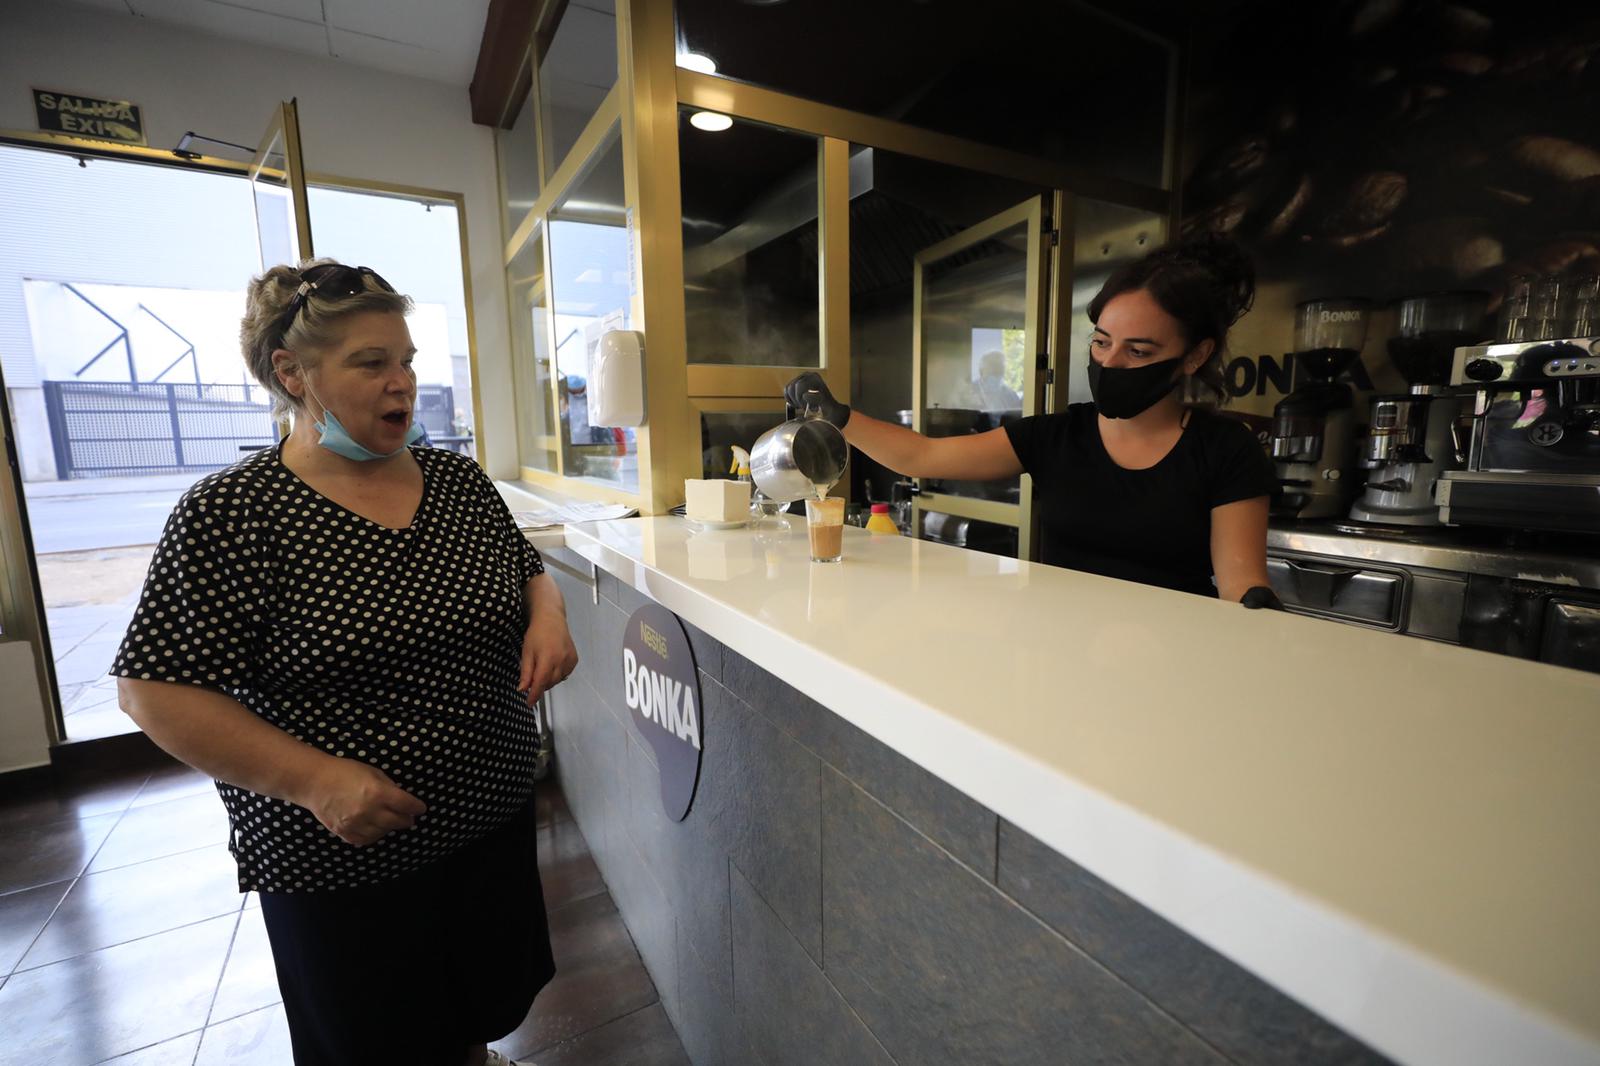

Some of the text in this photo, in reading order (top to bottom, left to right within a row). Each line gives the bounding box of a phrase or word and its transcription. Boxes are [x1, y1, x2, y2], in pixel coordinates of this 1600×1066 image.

[39, 93, 137, 122] SALIDA
[1320, 310, 1361, 323] BONKA
[623, 648, 701, 750] BONKA
